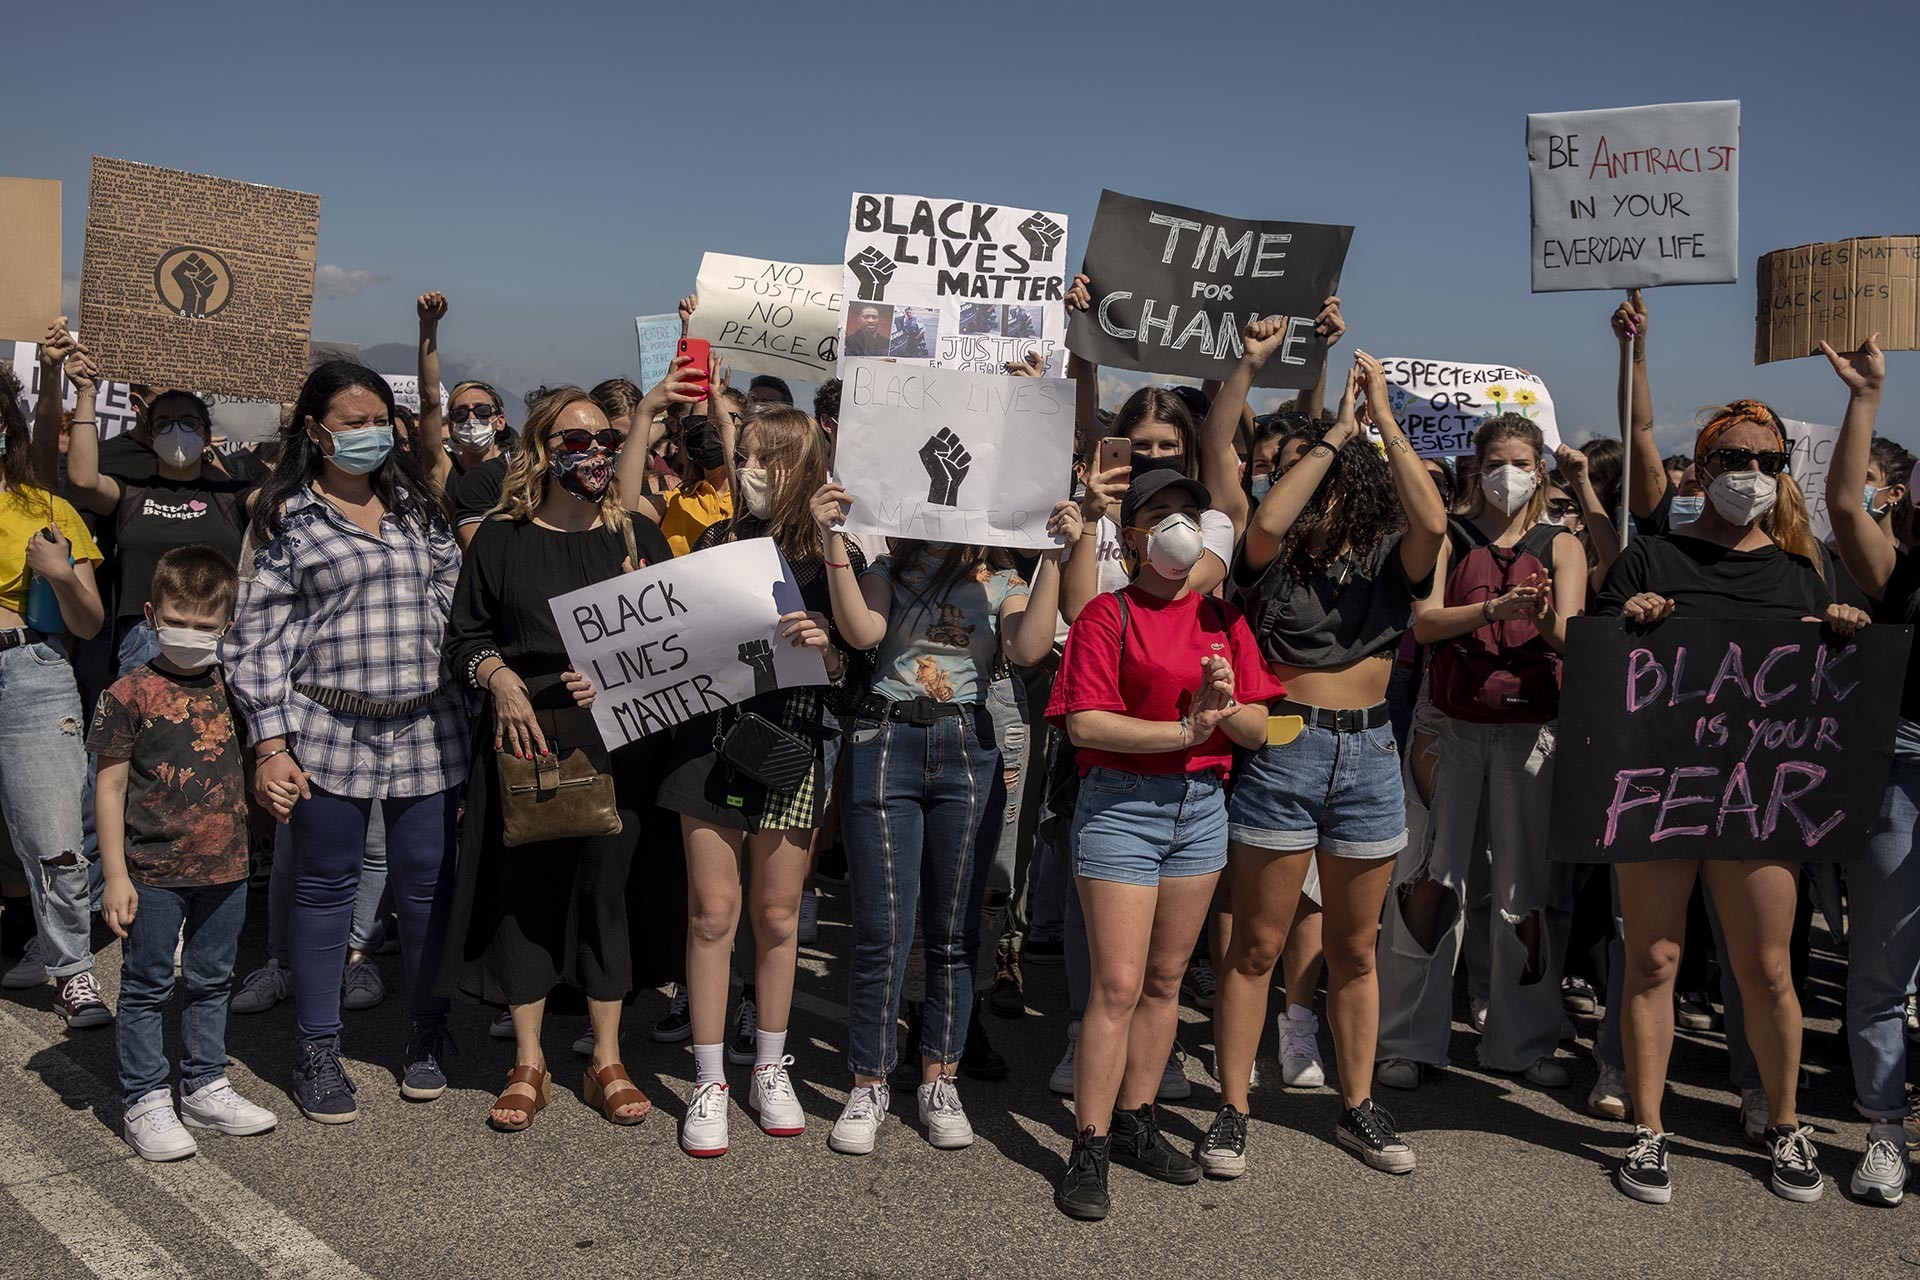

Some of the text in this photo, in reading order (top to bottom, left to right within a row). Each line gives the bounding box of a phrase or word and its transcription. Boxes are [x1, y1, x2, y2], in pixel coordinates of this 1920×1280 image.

[1548, 134, 1736, 180] BE ANTIRACIST
[855, 195, 998, 242] BLACK
[1570, 192, 1691, 219] IN YOUR
[894, 235, 1030, 274] LIVES
[1149, 210, 1292, 278] TIME
[1544, 233, 1706, 269] EVERYDAY LIFE
[1789, 247, 1849, 269] LIVES
[1858, 246, 1920, 260] MATTE
[761, 264, 803, 285] NO
[937, 270, 1063, 301] MATTER
[1190, 281, 1234, 302] FOR
[728, 276, 843, 311] JUSTICE
[1761, 284, 1889, 315] BLACK LIVES
[748, 302, 793, 328] NO
[1098, 291, 1316, 366] CHANE
[640, 326, 671, 343] POTERE
[719, 321, 810, 356] PEACE
[642, 353, 669, 367] POTERE
[1381, 360, 1463, 387] ESPECT
[853, 366, 1061, 415] BLACK LIVES
[1430, 392, 1481, 412] OR
[877, 501, 1034, 542] MATTER
[572, 580, 688, 645] BLACK
[592, 633, 689, 692] LIVES
[1626, 641, 1860, 713] BLACK
[611, 674, 733, 744] MATTER
[1694, 713, 1843, 763] IS YOUR
[1603, 760, 1847, 848] FEAR
